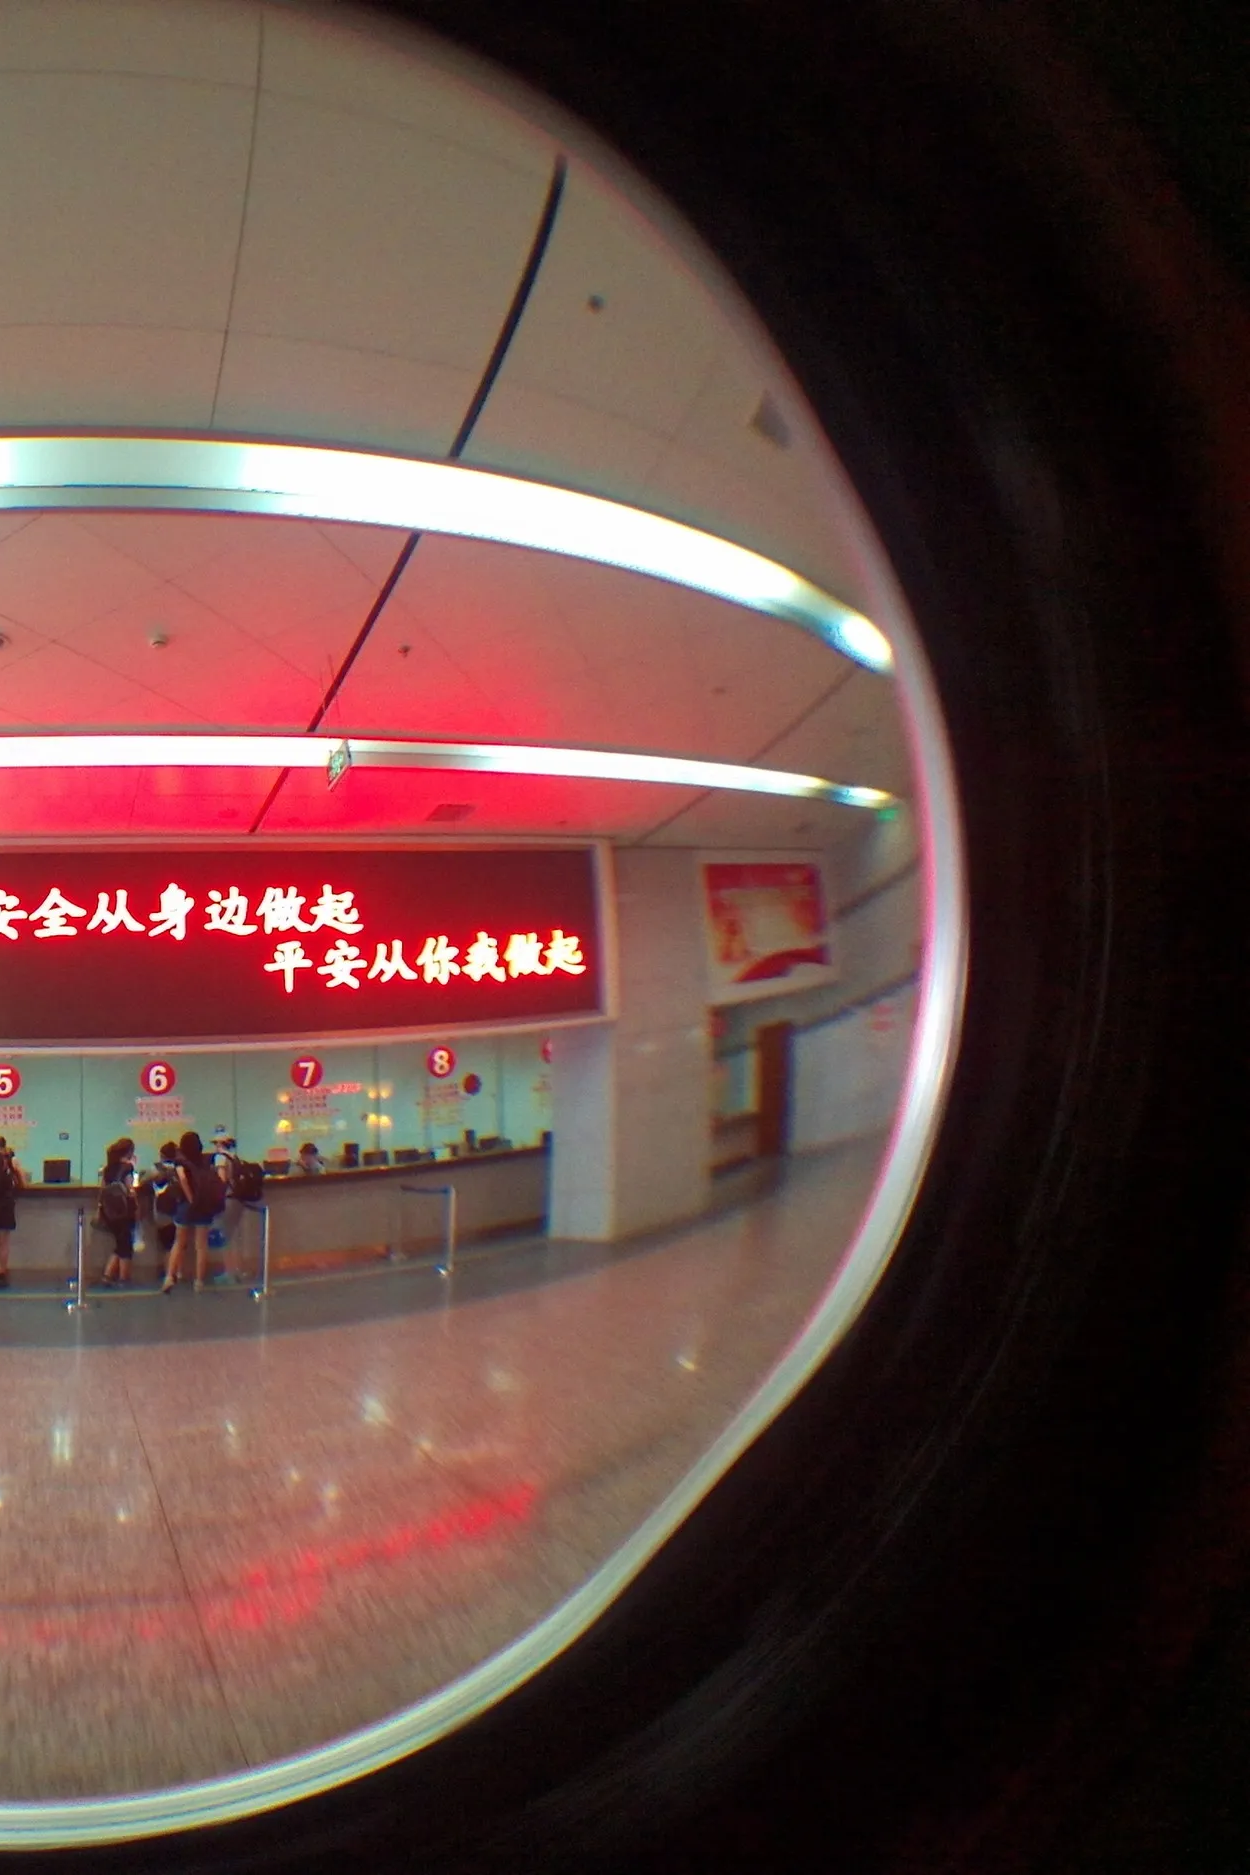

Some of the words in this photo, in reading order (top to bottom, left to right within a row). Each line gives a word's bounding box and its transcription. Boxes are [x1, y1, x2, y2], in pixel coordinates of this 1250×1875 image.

[263, 929, 587, 993] 平安从你我做起
[298, 1061, 316, 1087] 7
[433, 1050, 450, 1075] 8
[149, 1065, 168, 1092] 6
